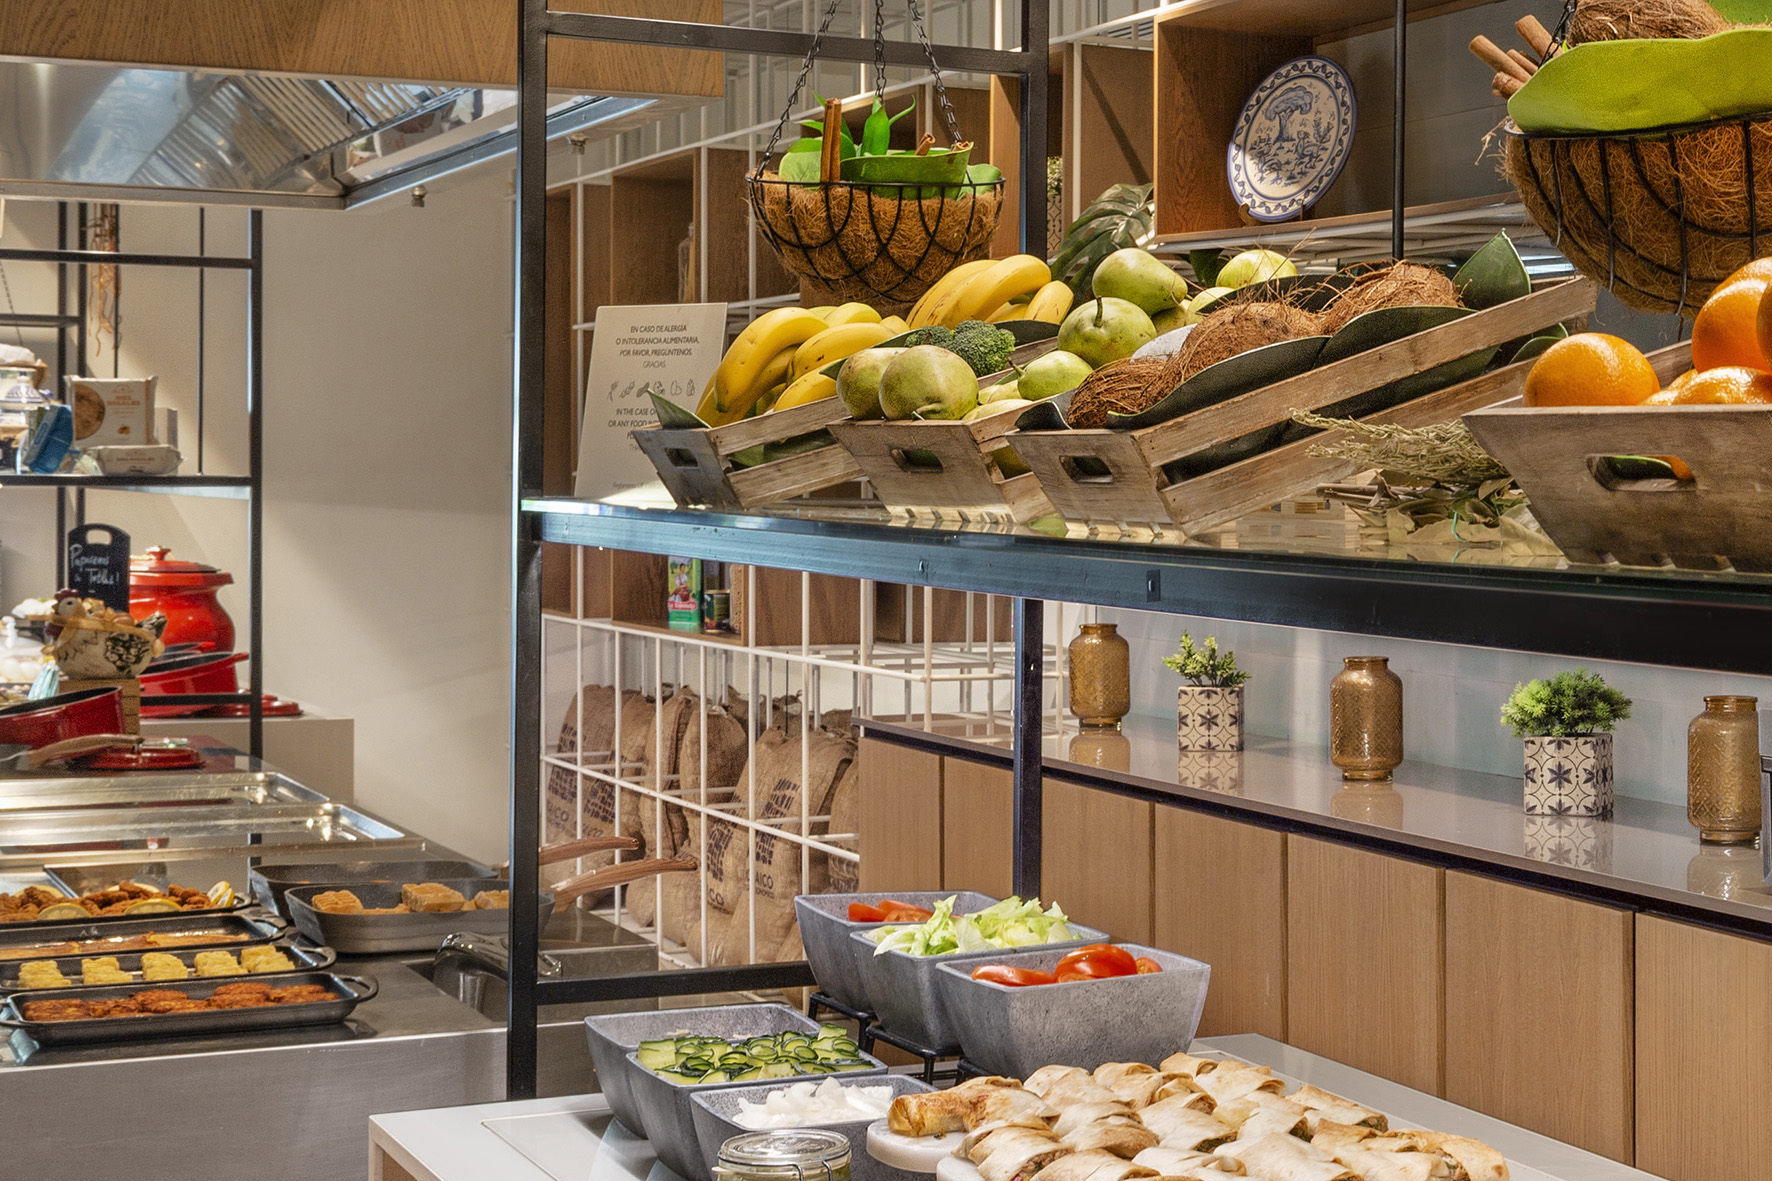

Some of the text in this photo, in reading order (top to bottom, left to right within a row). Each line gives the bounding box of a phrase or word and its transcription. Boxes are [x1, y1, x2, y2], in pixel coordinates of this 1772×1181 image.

[640, 325, 655, 333] CASO
[622, 337, 662, 345] INTOLERANCIA
[620, 349, 631, 357] POR
[623, 408, 634, 416] THE
[635, 408, 649, 416] CASE
